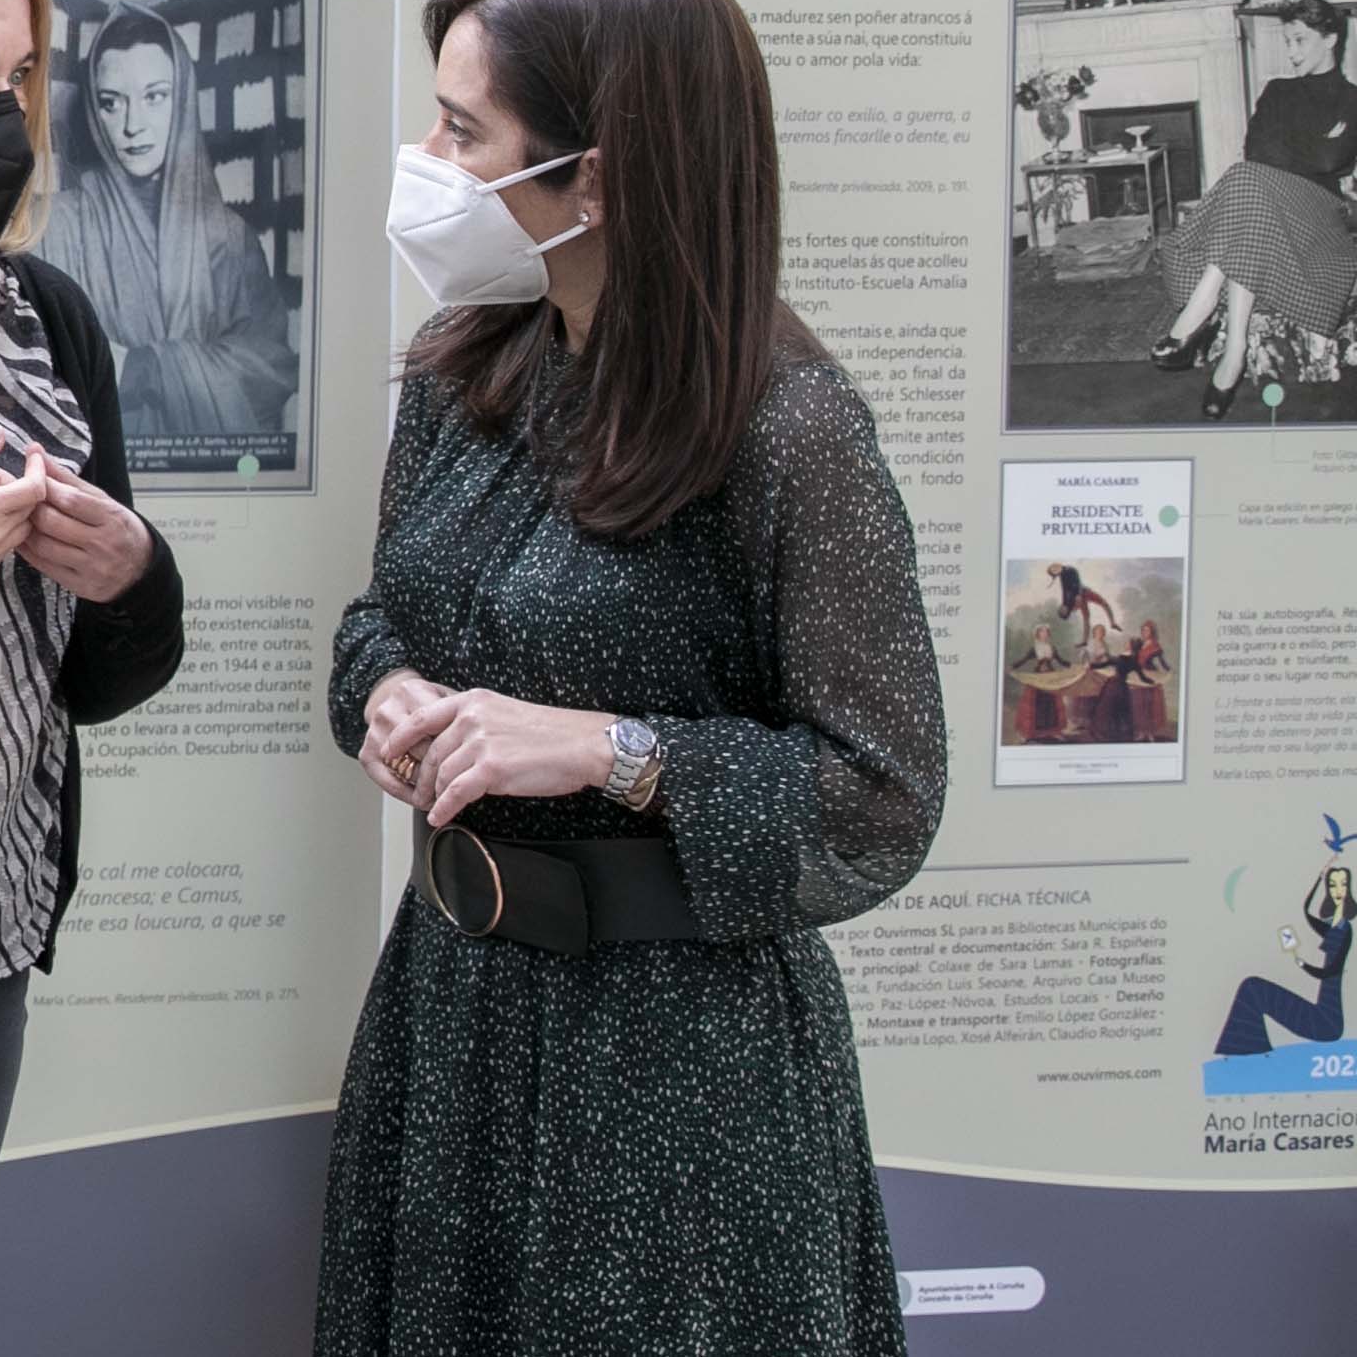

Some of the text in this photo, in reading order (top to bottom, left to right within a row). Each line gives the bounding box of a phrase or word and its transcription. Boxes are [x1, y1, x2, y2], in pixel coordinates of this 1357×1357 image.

[1057, 475, 1139, 487] MARÍA CASARES
[1051, 504, 1143, 518] RESIDENTE
[1041, 521, 1152, 535] PRIVILEXIADA
[98, 860, 244, 881] cal me colocara,
[75, 886, 242, 909] francesa; e Camus,
[904, 894, 925, 910] DE
[976, 892, 1022, 907] FICHA
[1026, 888, 1091, 906] TÉCNICA
[97, 913, 286, 933] esa loucura, a que se
[847, 916, 1167, 943] por Ouvirmos SL para as Bibliotecas Municipais do
[1036, 1067, 1162, 1082] www.ouvirmos.com
[1310, 1054, 1357, 1078] 202
[1203, 1111, 1246, 1132] Ano
[1204, 1131, 1354, 1154] María Casares
